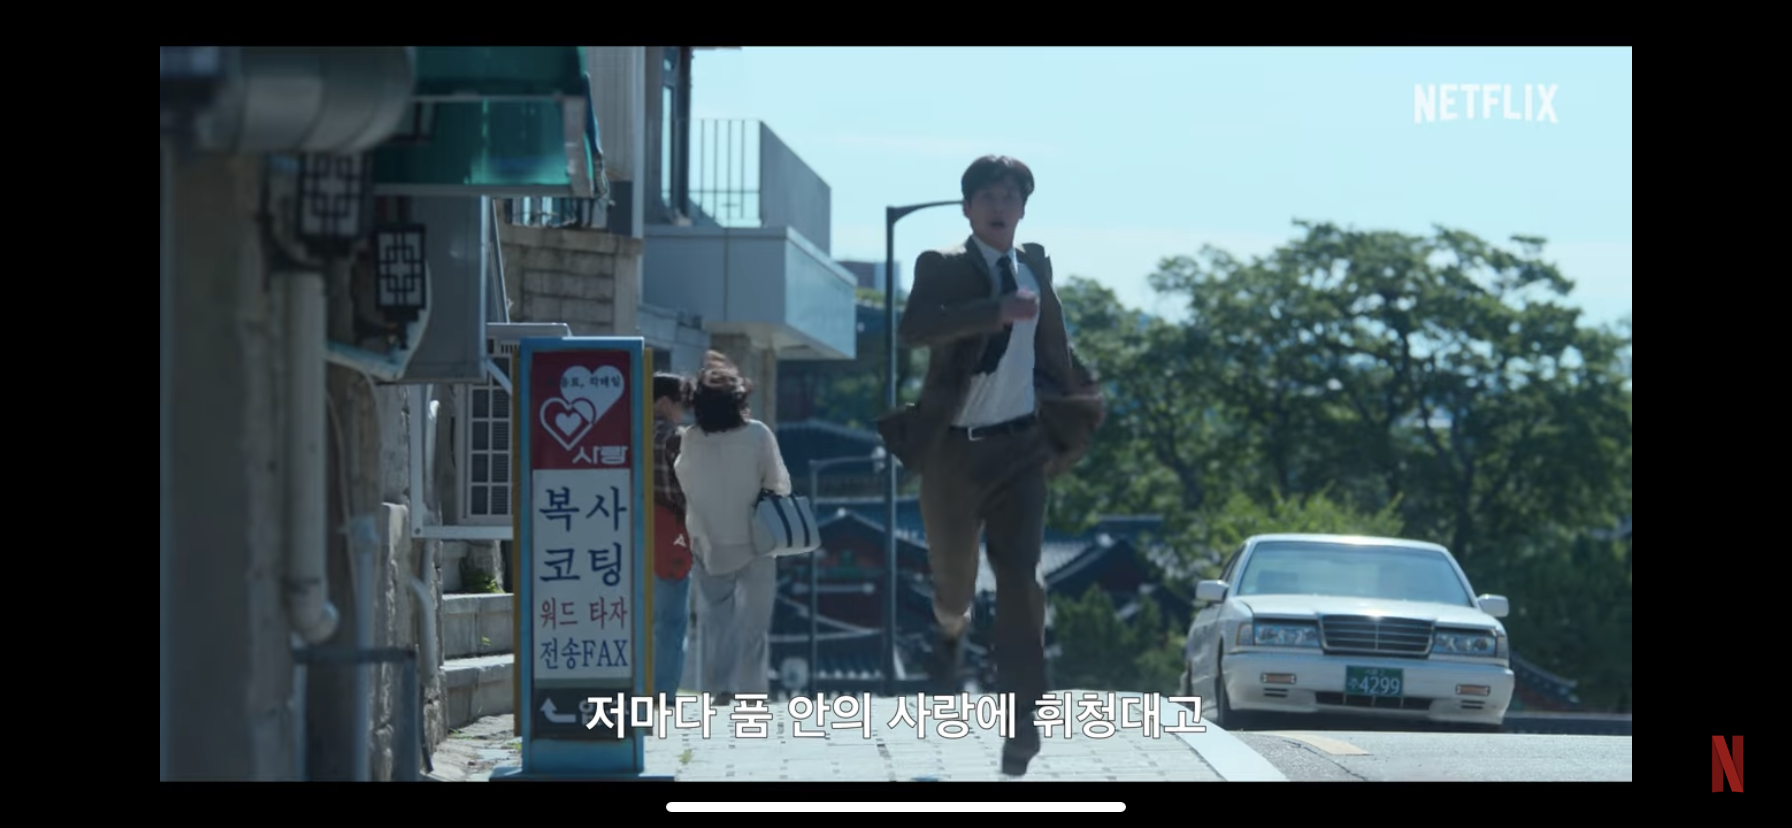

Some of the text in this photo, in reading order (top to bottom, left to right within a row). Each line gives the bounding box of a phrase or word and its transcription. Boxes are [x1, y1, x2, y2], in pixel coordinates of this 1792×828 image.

[572, 446, 628, 465] 사랑
[539, 486, 627, 532] 복사
[539, 541, 623, 586] 코팅
[540, 596, 628, 630] 워드 타자
